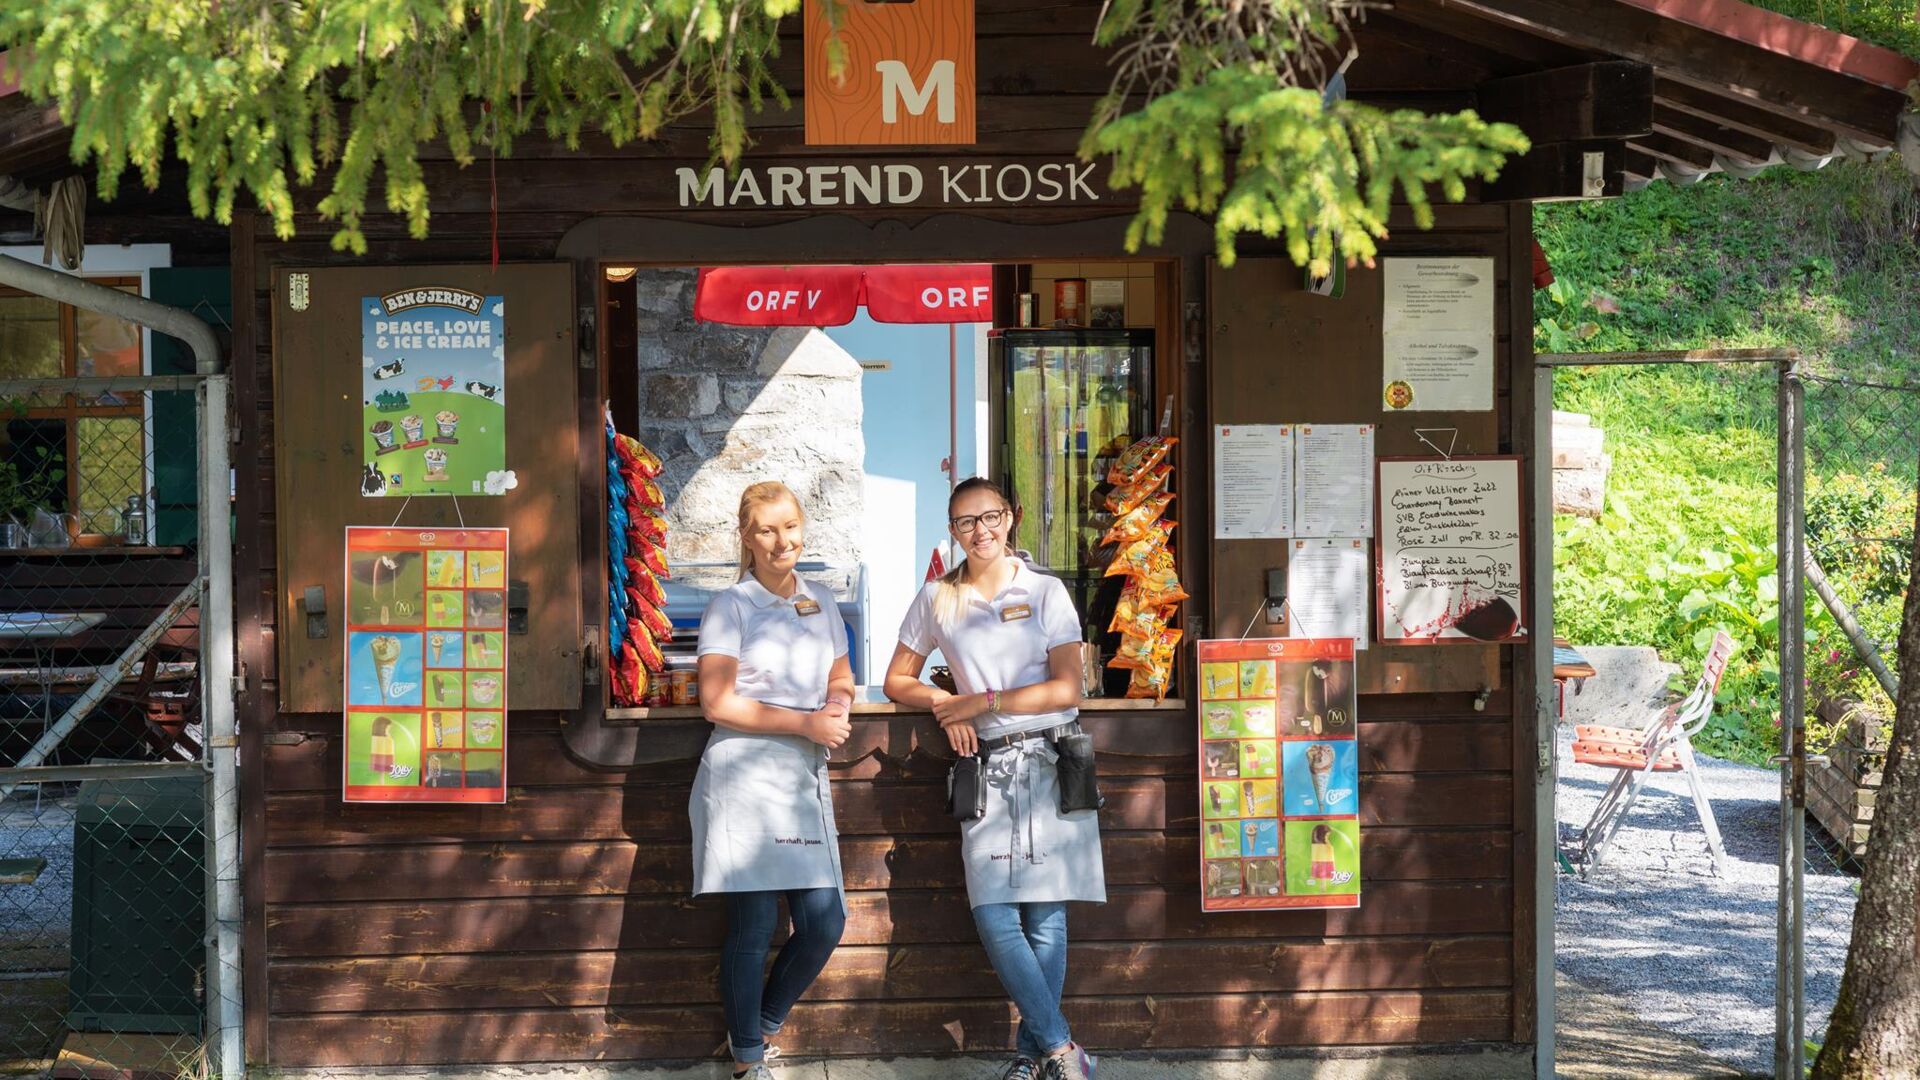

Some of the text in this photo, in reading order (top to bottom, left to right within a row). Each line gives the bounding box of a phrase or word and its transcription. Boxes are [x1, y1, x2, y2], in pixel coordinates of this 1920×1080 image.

[875, 59, 955, 123] M
[675, 162, 1099, 207] MAREND KIOSK
[746, 289, 822, 311] ORF V
[921, 286, 990, 308] ORF
[376, 321, 491, 336] PEACE, LOVE
[376, 336, 491, 349] & ICE CREAM
[1426, 485, 1468, 495] Veltliner
